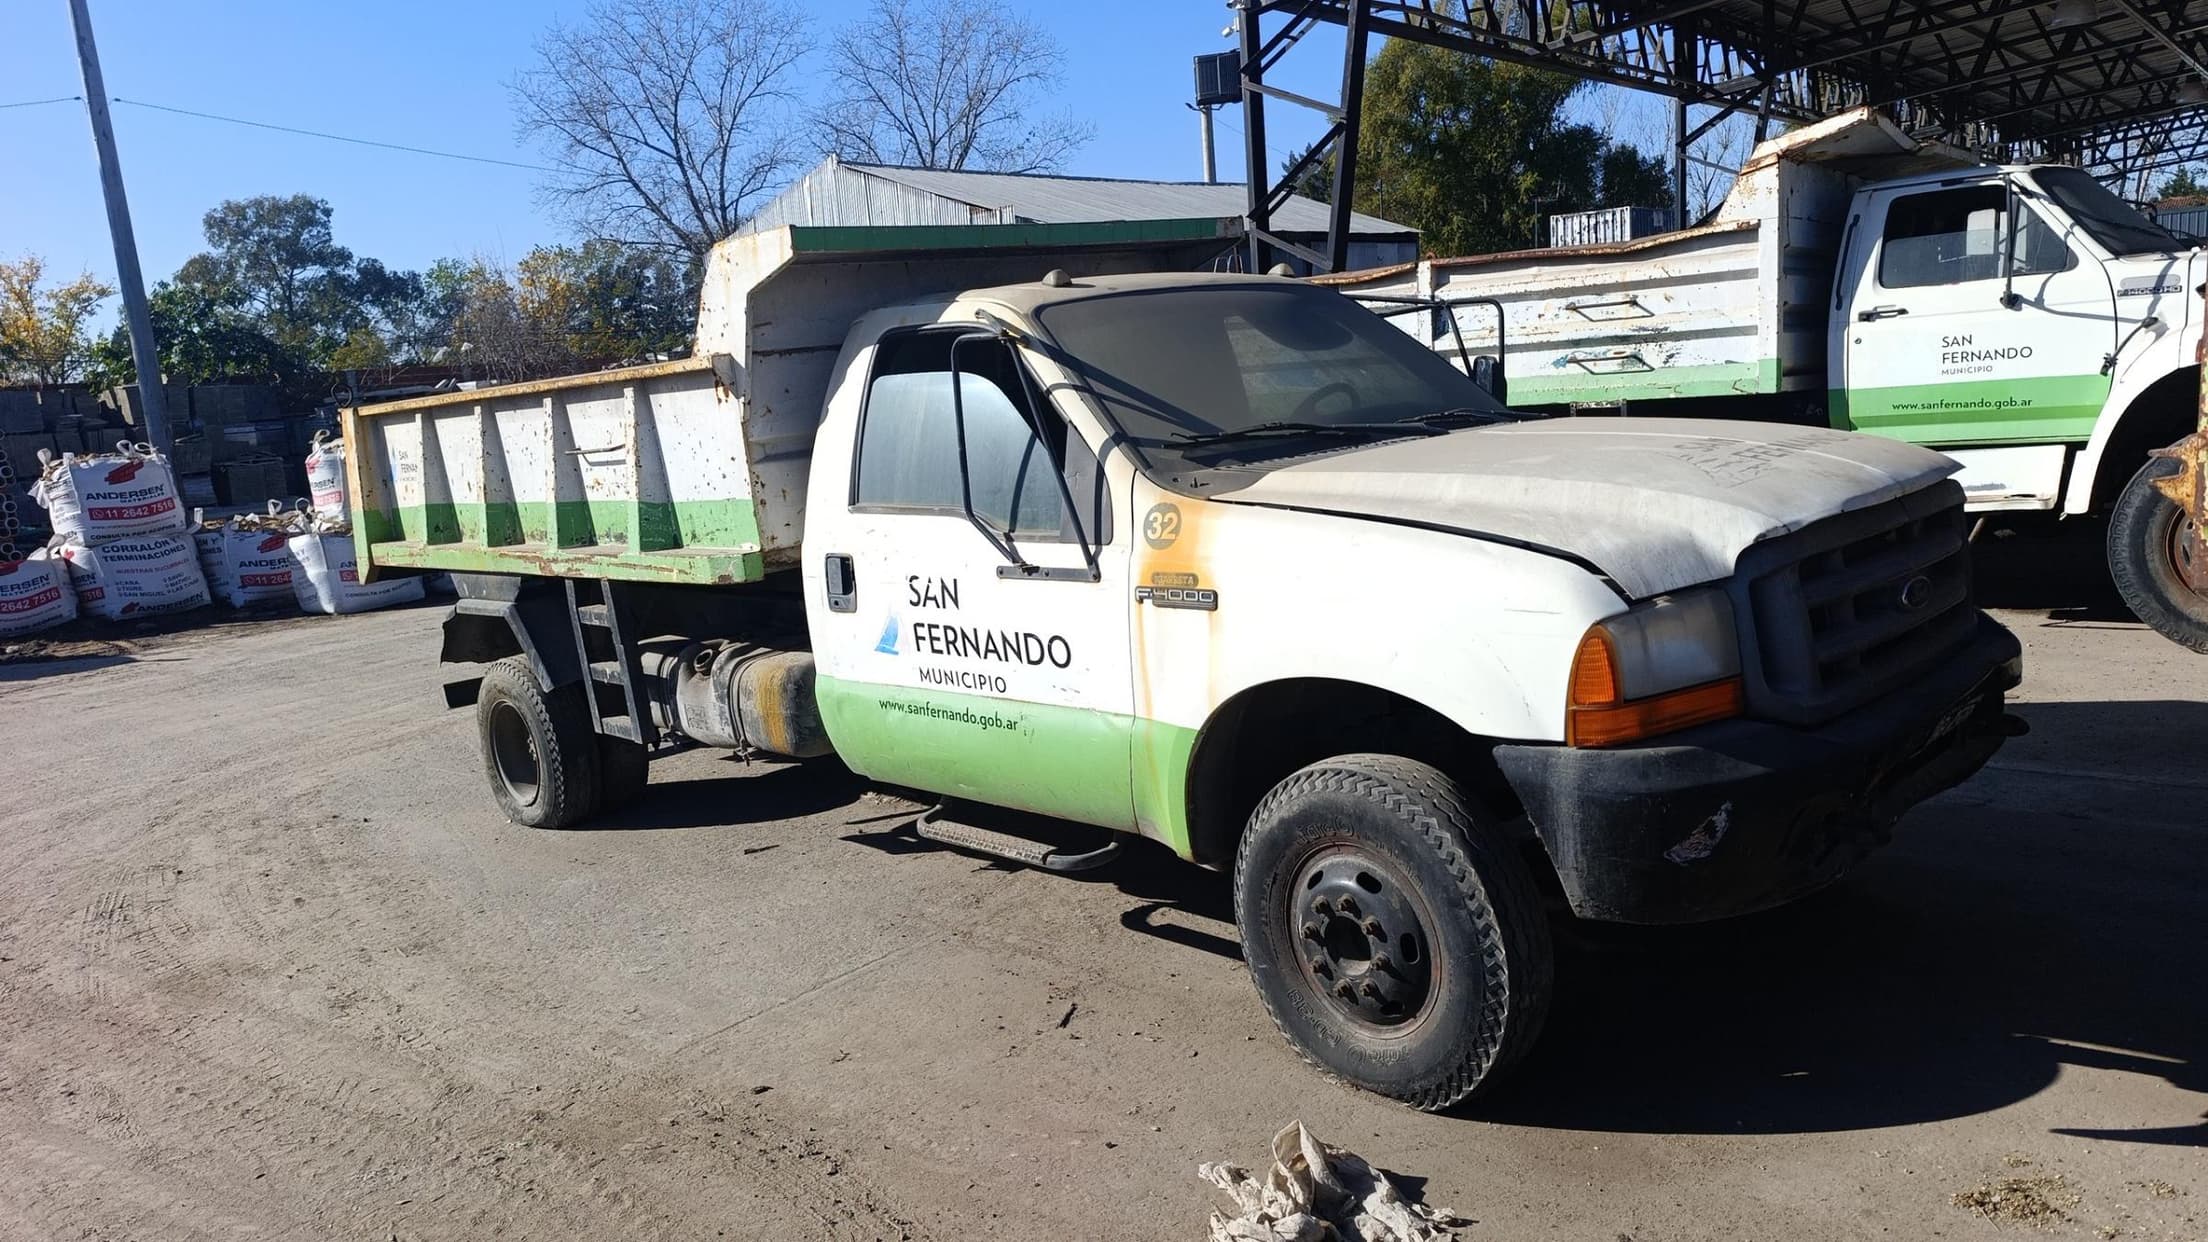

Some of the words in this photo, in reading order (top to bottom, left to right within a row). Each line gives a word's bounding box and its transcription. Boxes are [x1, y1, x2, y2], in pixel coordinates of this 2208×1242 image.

[1942, 334, 1972, 348] SAN
[1942, 346, 2033, 365] FERNANDO
[1941, 365, 1993, 376] MUNICIPIO
[1891, 396, 2033, 410] www.sanfernando.gob.ar
[86, 484, 165, 501] ANDERSEN
[105, 509, 118, 518] 11
[121, 507, 149, 518] 2642
[151, 500, 174, 513] 7516
[1147, 510, 1178, 541] 32
[102, 538, 170, 554] CORRALÓN
[102, 543, 187, 563] TERMINACIONES
[239, 557, 290, 568] ANDER
[0, 573, 50, 593] ERSEN
[271, 573, 290, 585] 264
[1, 599, 31, 612] 2642
[32, 590, 59, 606] 7516
[908, 575, 960, 611] SAN
[913, 622, 1072, 669] FERNANDO
[918, 666, 1008, 694] MUNICIPIO
[878, 698, 1019, 732] www.sanfernando.gob.ar
